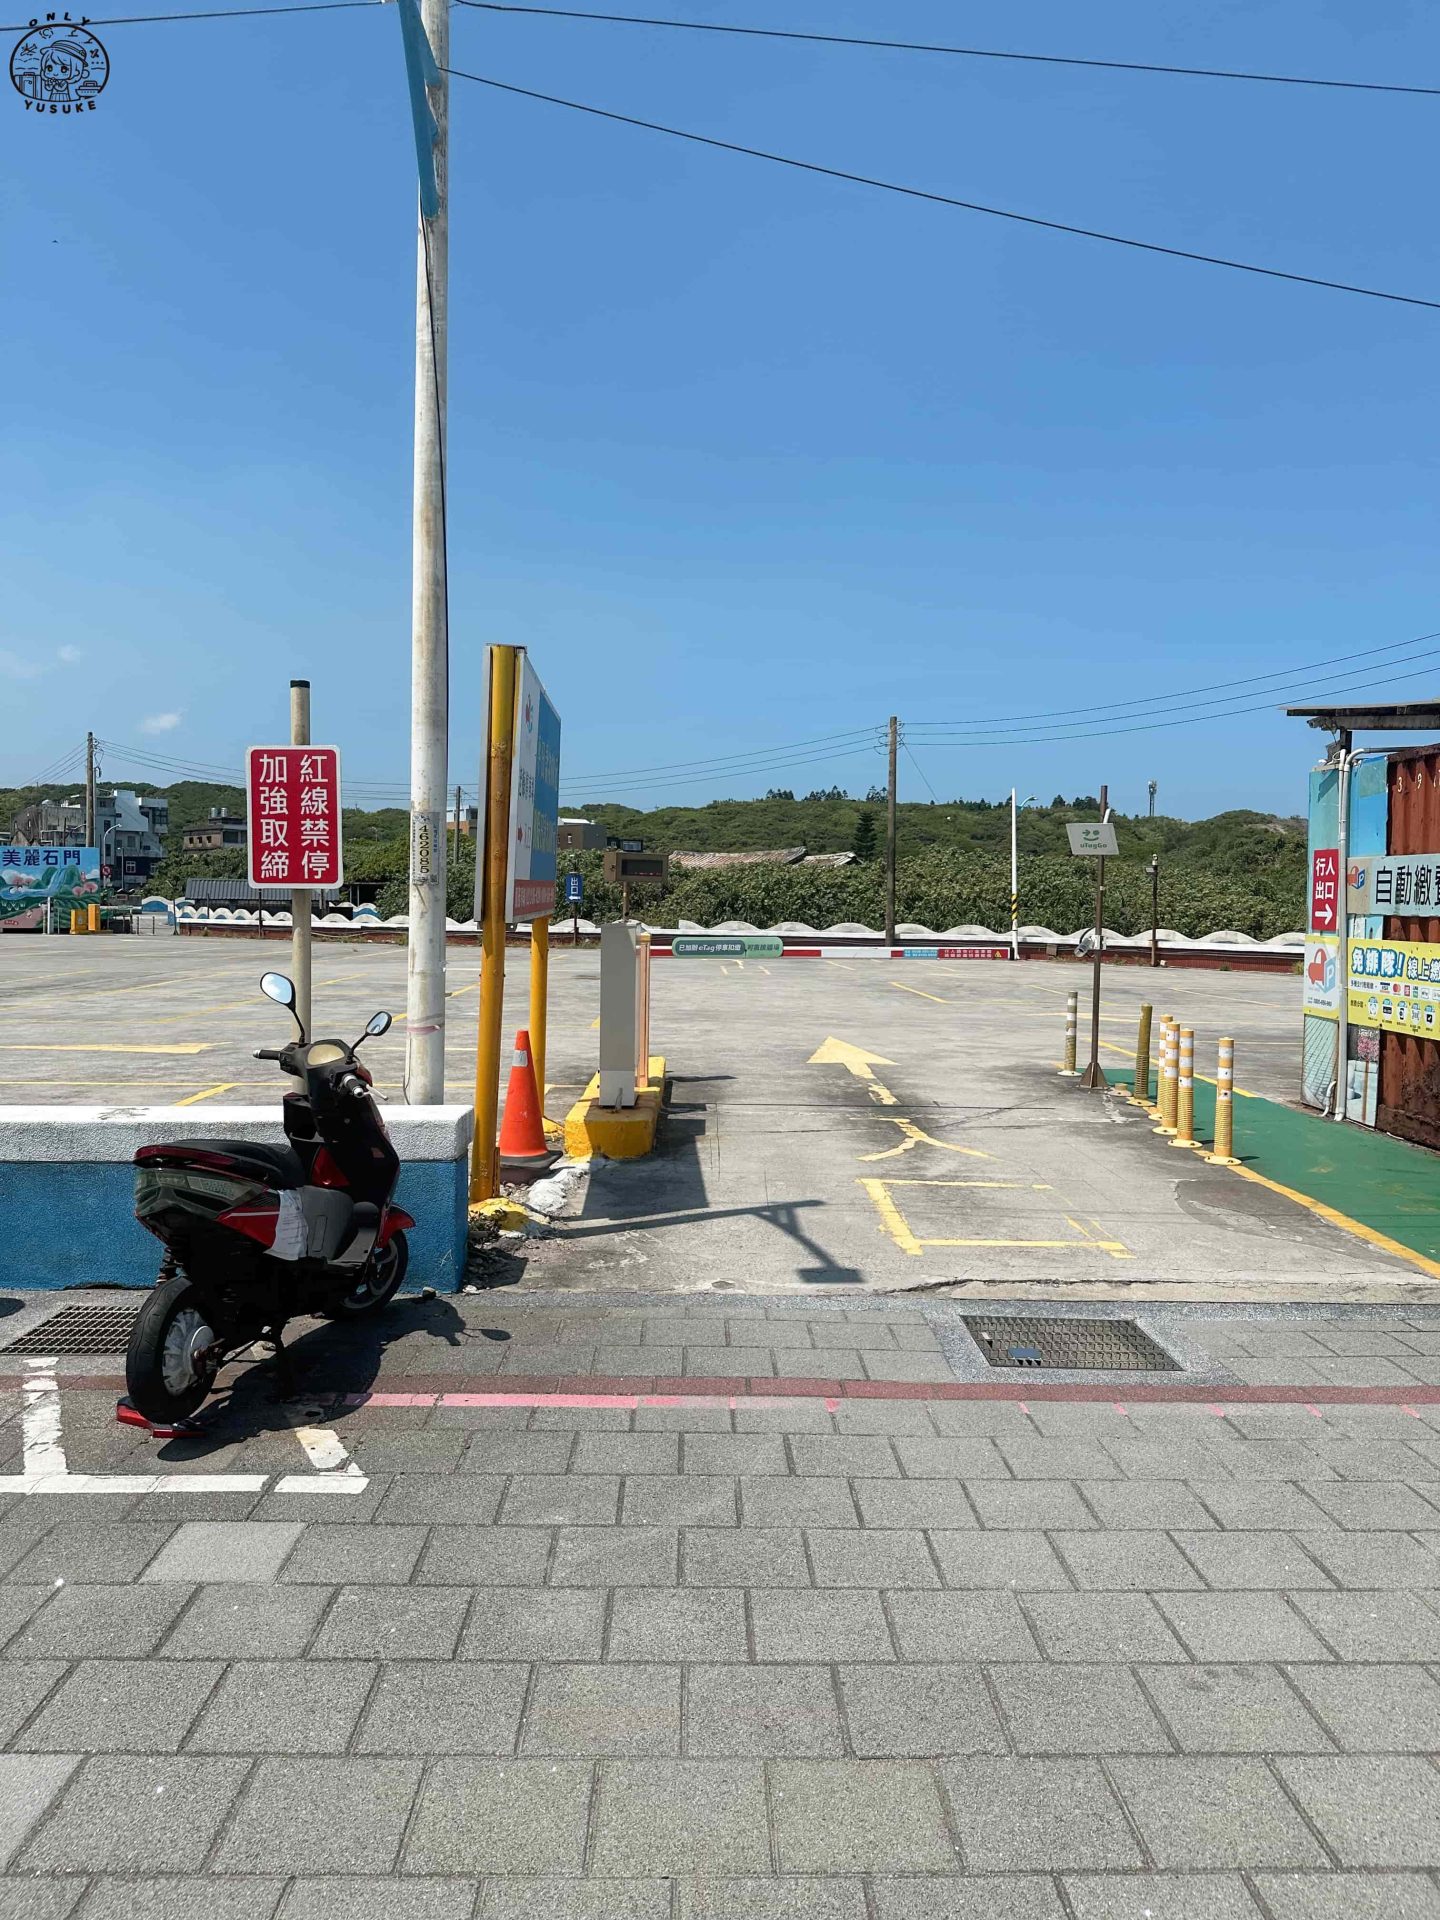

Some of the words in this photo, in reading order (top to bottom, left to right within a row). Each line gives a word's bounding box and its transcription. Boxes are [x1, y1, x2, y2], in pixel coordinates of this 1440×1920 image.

[259, 754, 289, 879] 加強取締
[300, 754, 330, 879] 紅線禁停
[2, 849, 81, 867] 美麗石門
[419, 824, 430, 874] 462085
[1315, 856, 1336, 877] 行人
[570, 877, 579, 895] 出口
[1315, 880, 1335, 900] 出口
